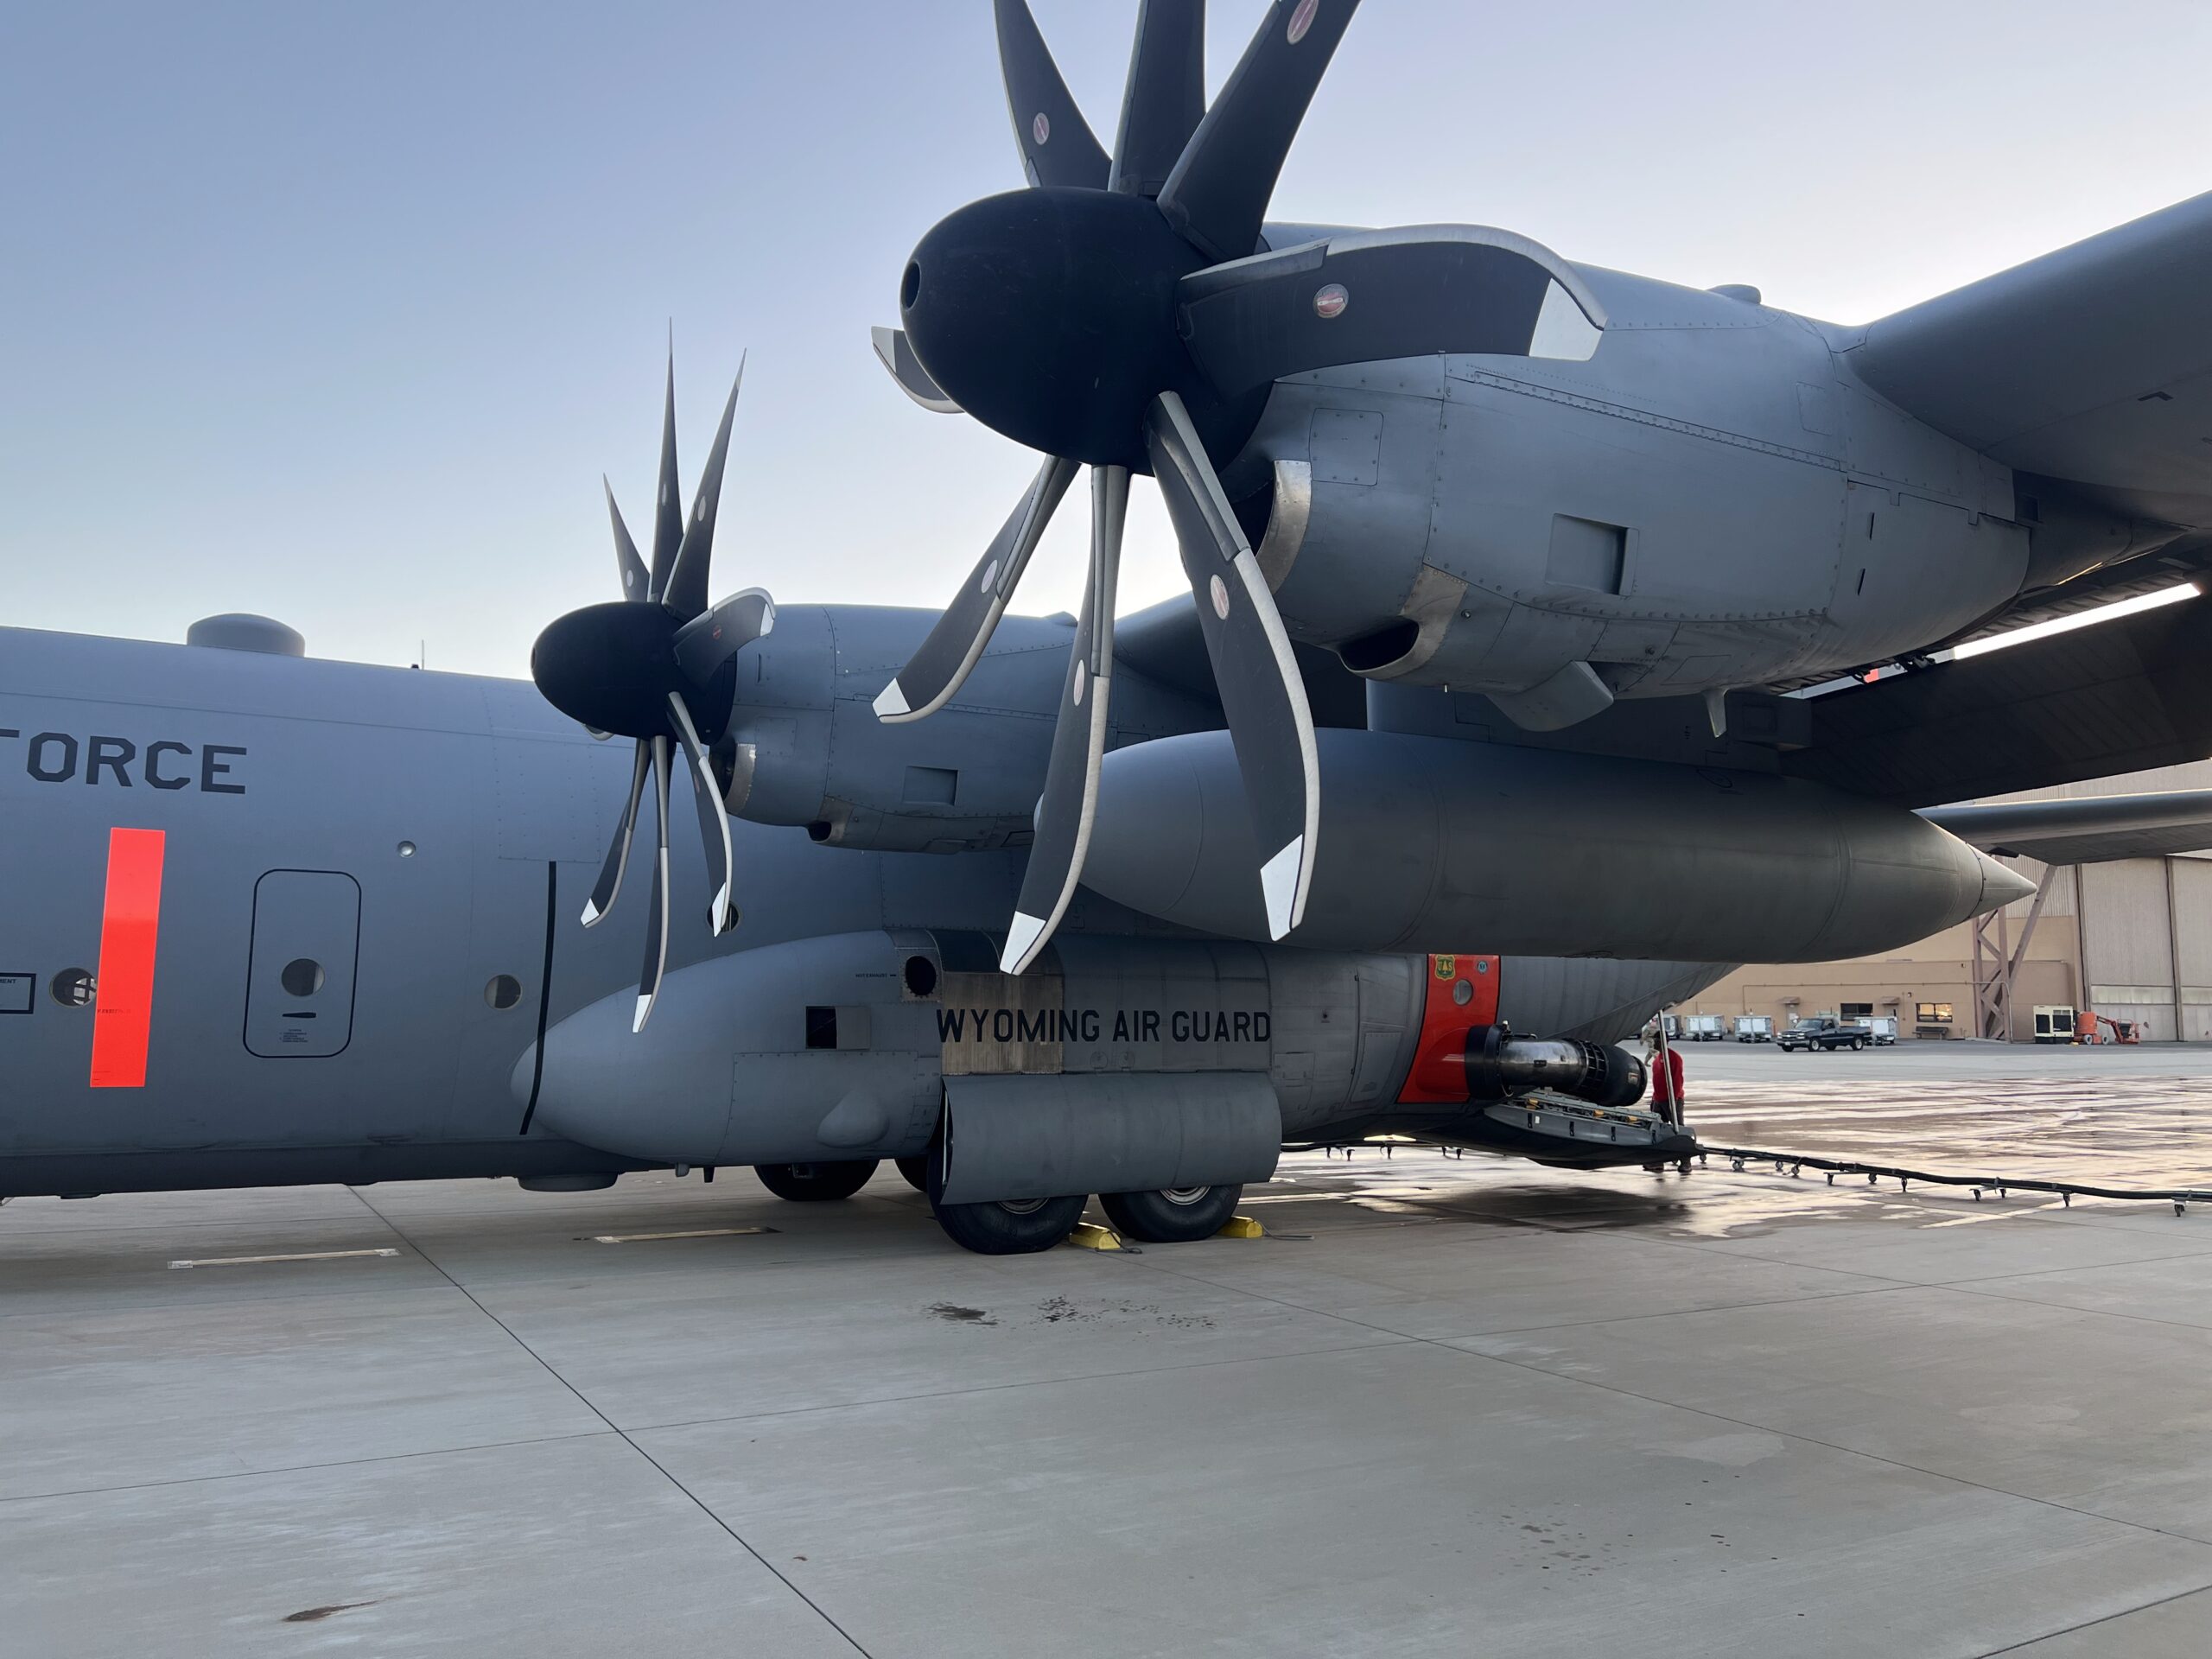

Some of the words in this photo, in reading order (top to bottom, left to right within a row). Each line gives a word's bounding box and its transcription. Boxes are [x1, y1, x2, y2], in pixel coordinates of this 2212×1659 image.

[0, 728, 247, 794] ORCE
[936, 1008, 1100, 1042] WYOMING
[1112, 1009, 1160, 1042] AIR
[1172, 1010, 1271, 1042] GUARD
